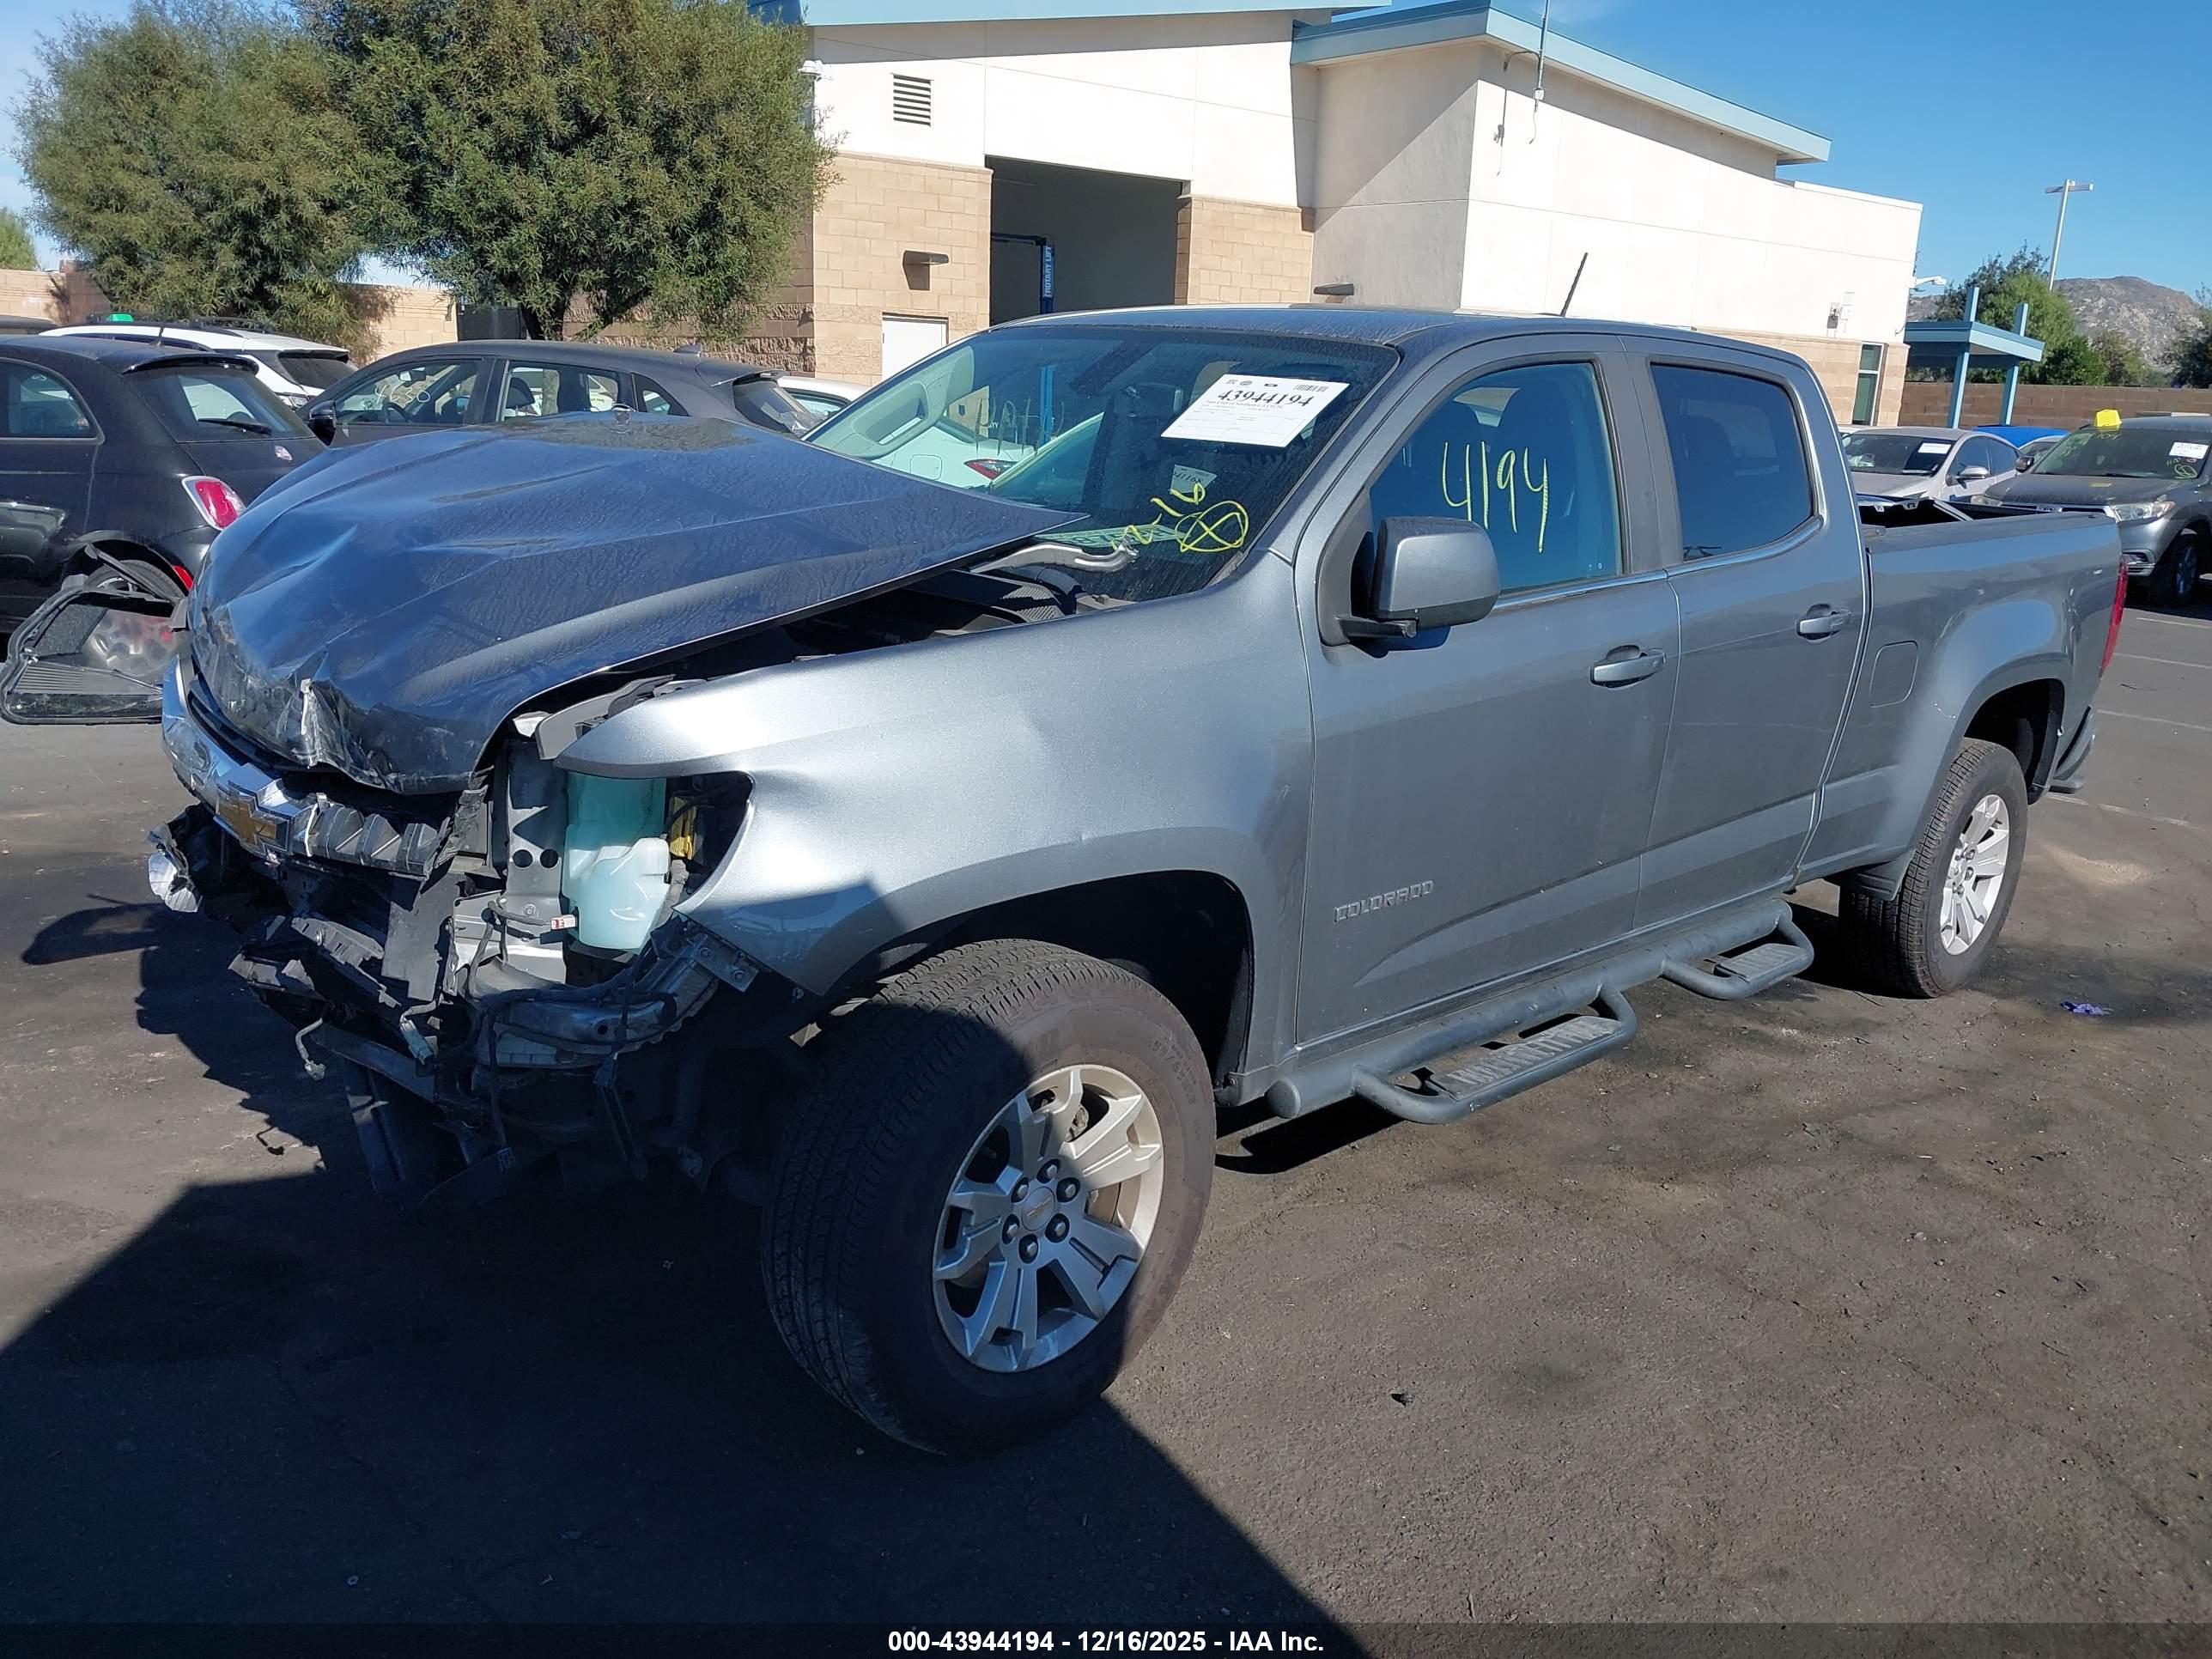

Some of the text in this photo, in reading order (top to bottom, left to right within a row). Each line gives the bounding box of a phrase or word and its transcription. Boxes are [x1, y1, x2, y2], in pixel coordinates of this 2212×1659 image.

[1218, 389, 1315, 407] 43944194
[1442, 441, 1549, 554] 4194
[1334, 878, 1434, 923] COLORADO
